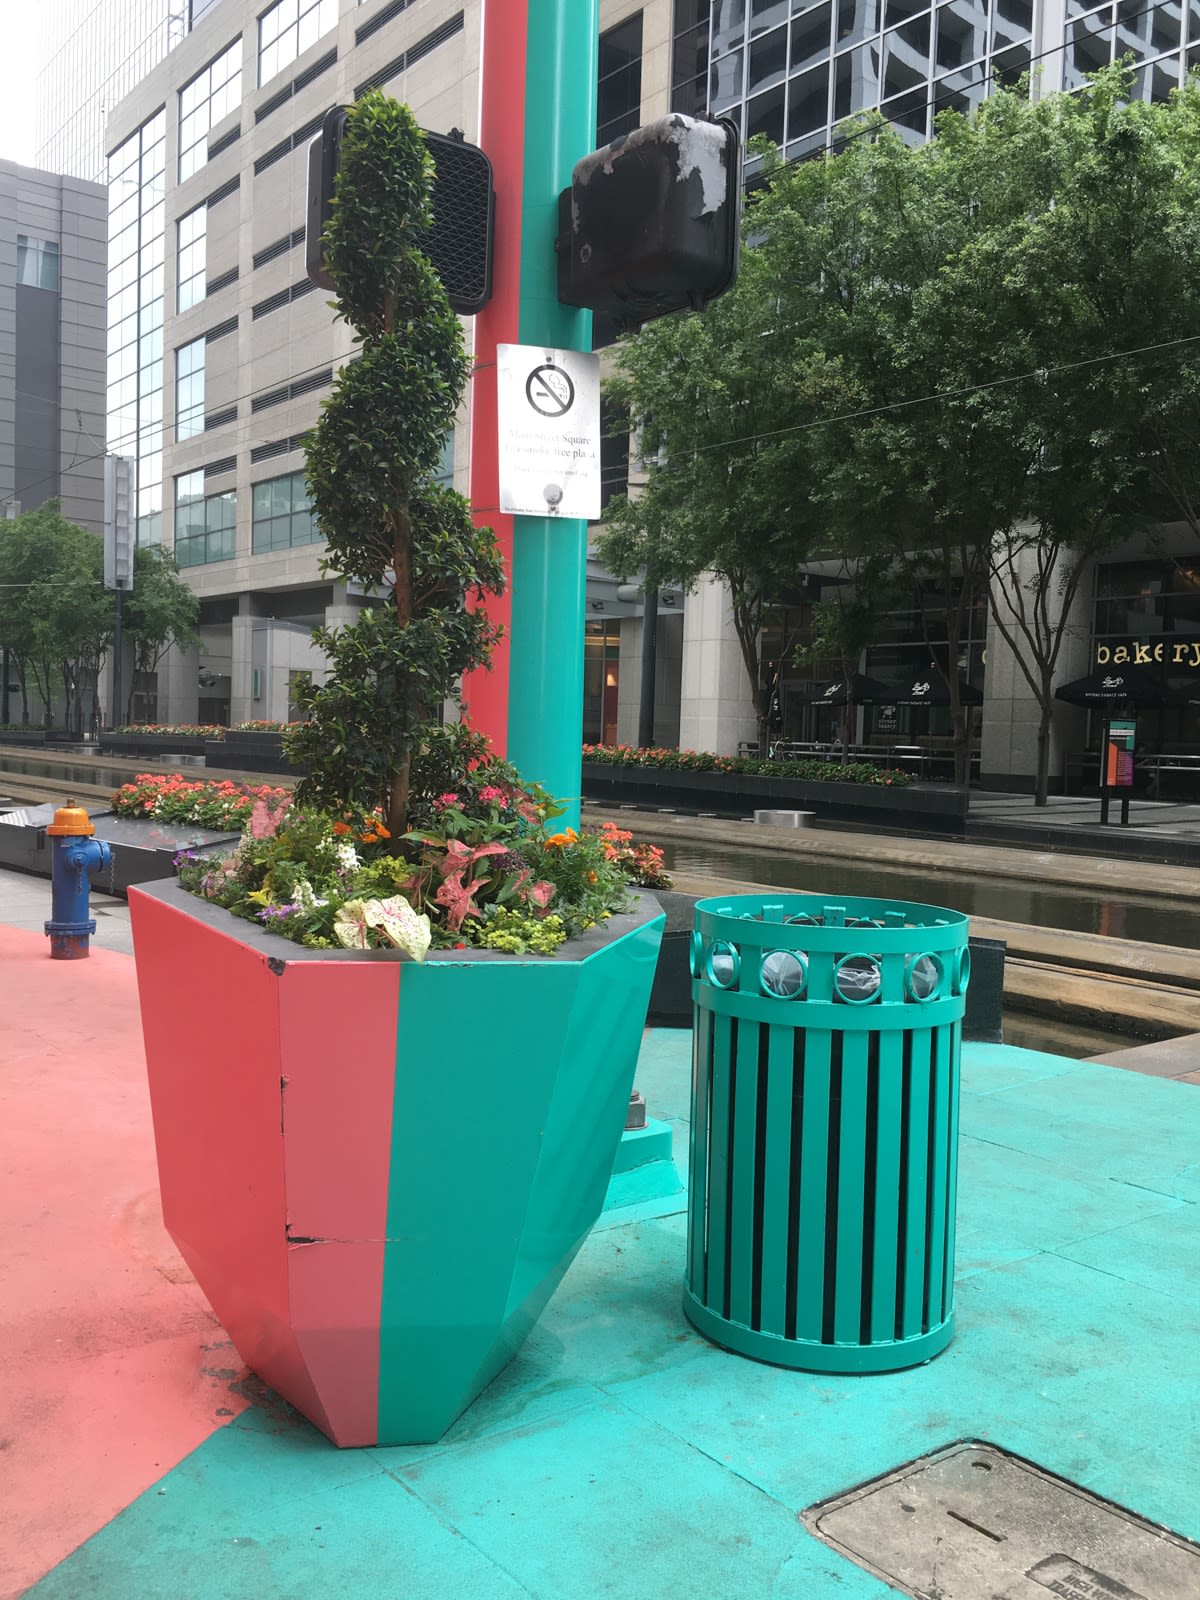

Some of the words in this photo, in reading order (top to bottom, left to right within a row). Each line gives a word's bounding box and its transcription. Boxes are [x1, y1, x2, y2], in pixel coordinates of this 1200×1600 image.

[562, 433, 591, 446] Square
[572, 448, 596, 461] plaa
[1097, 641, 1200, 668] bakery
[1062, 1574, 1094, 1593] HIGH
